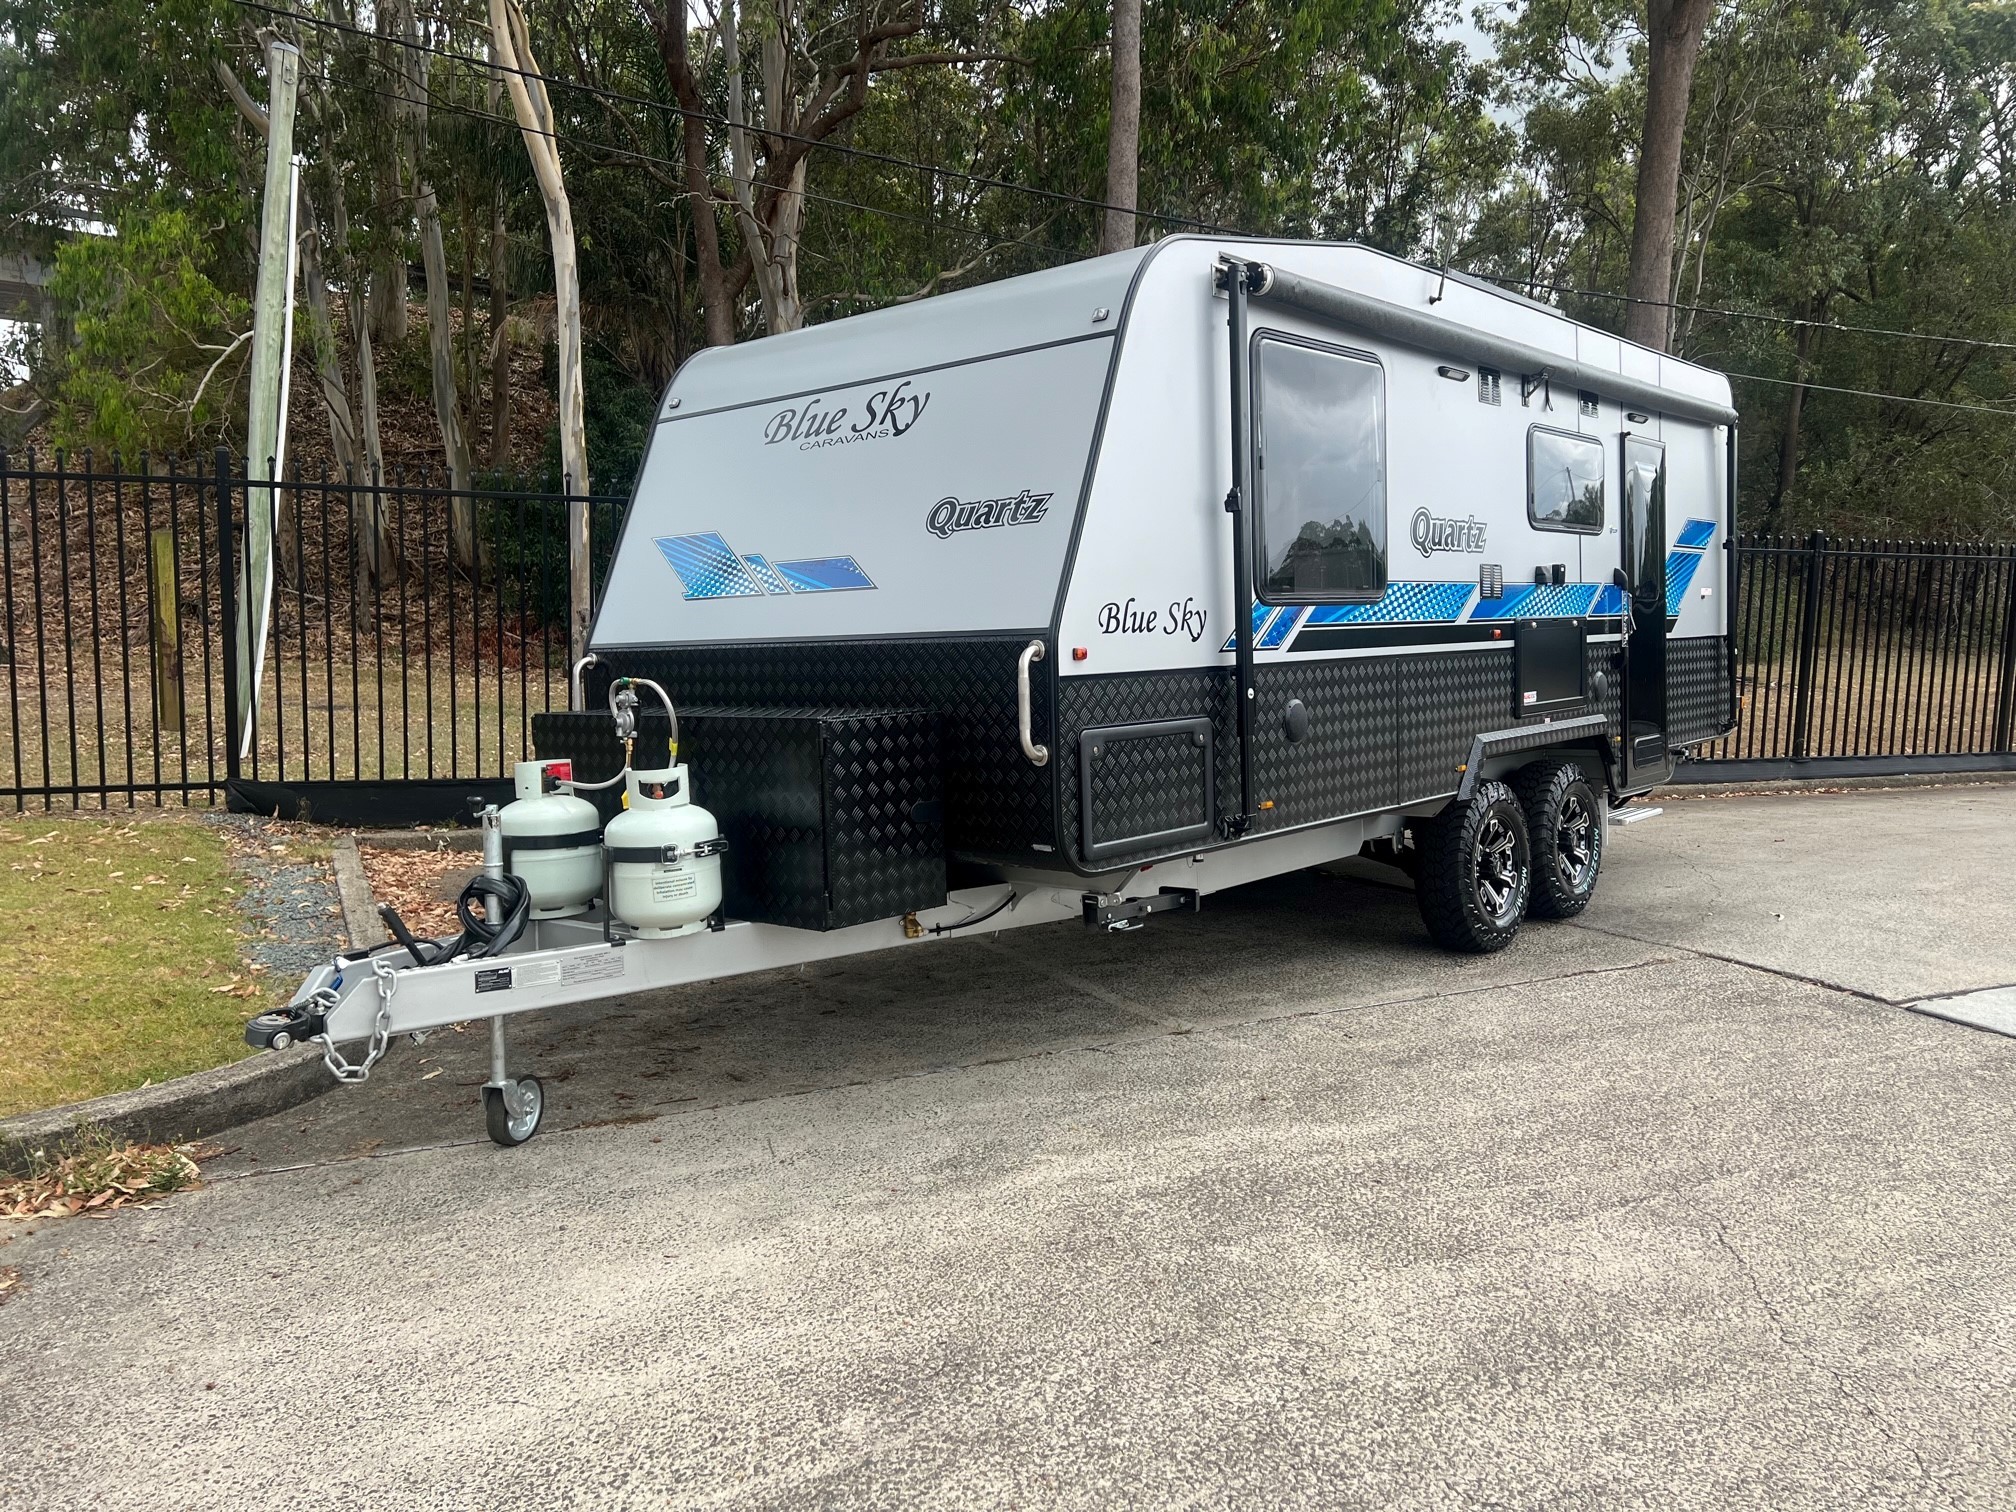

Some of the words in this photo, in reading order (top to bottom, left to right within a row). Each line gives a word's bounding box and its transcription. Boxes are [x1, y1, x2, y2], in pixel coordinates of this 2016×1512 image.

[763, 398, 848, 446] Blue
[851, 380, 931, 437] Sky
[799, 428, 889, 451] CARAVANS
[926, 489, 1054, 540] Quartz
[1410, 506, 1488, 559] Quartz
[1098, 597, 1158, 634] Blue
[1163, 597, 1207, 643] Sky
[1583, 828, 1599, 891] MUDZILLA
